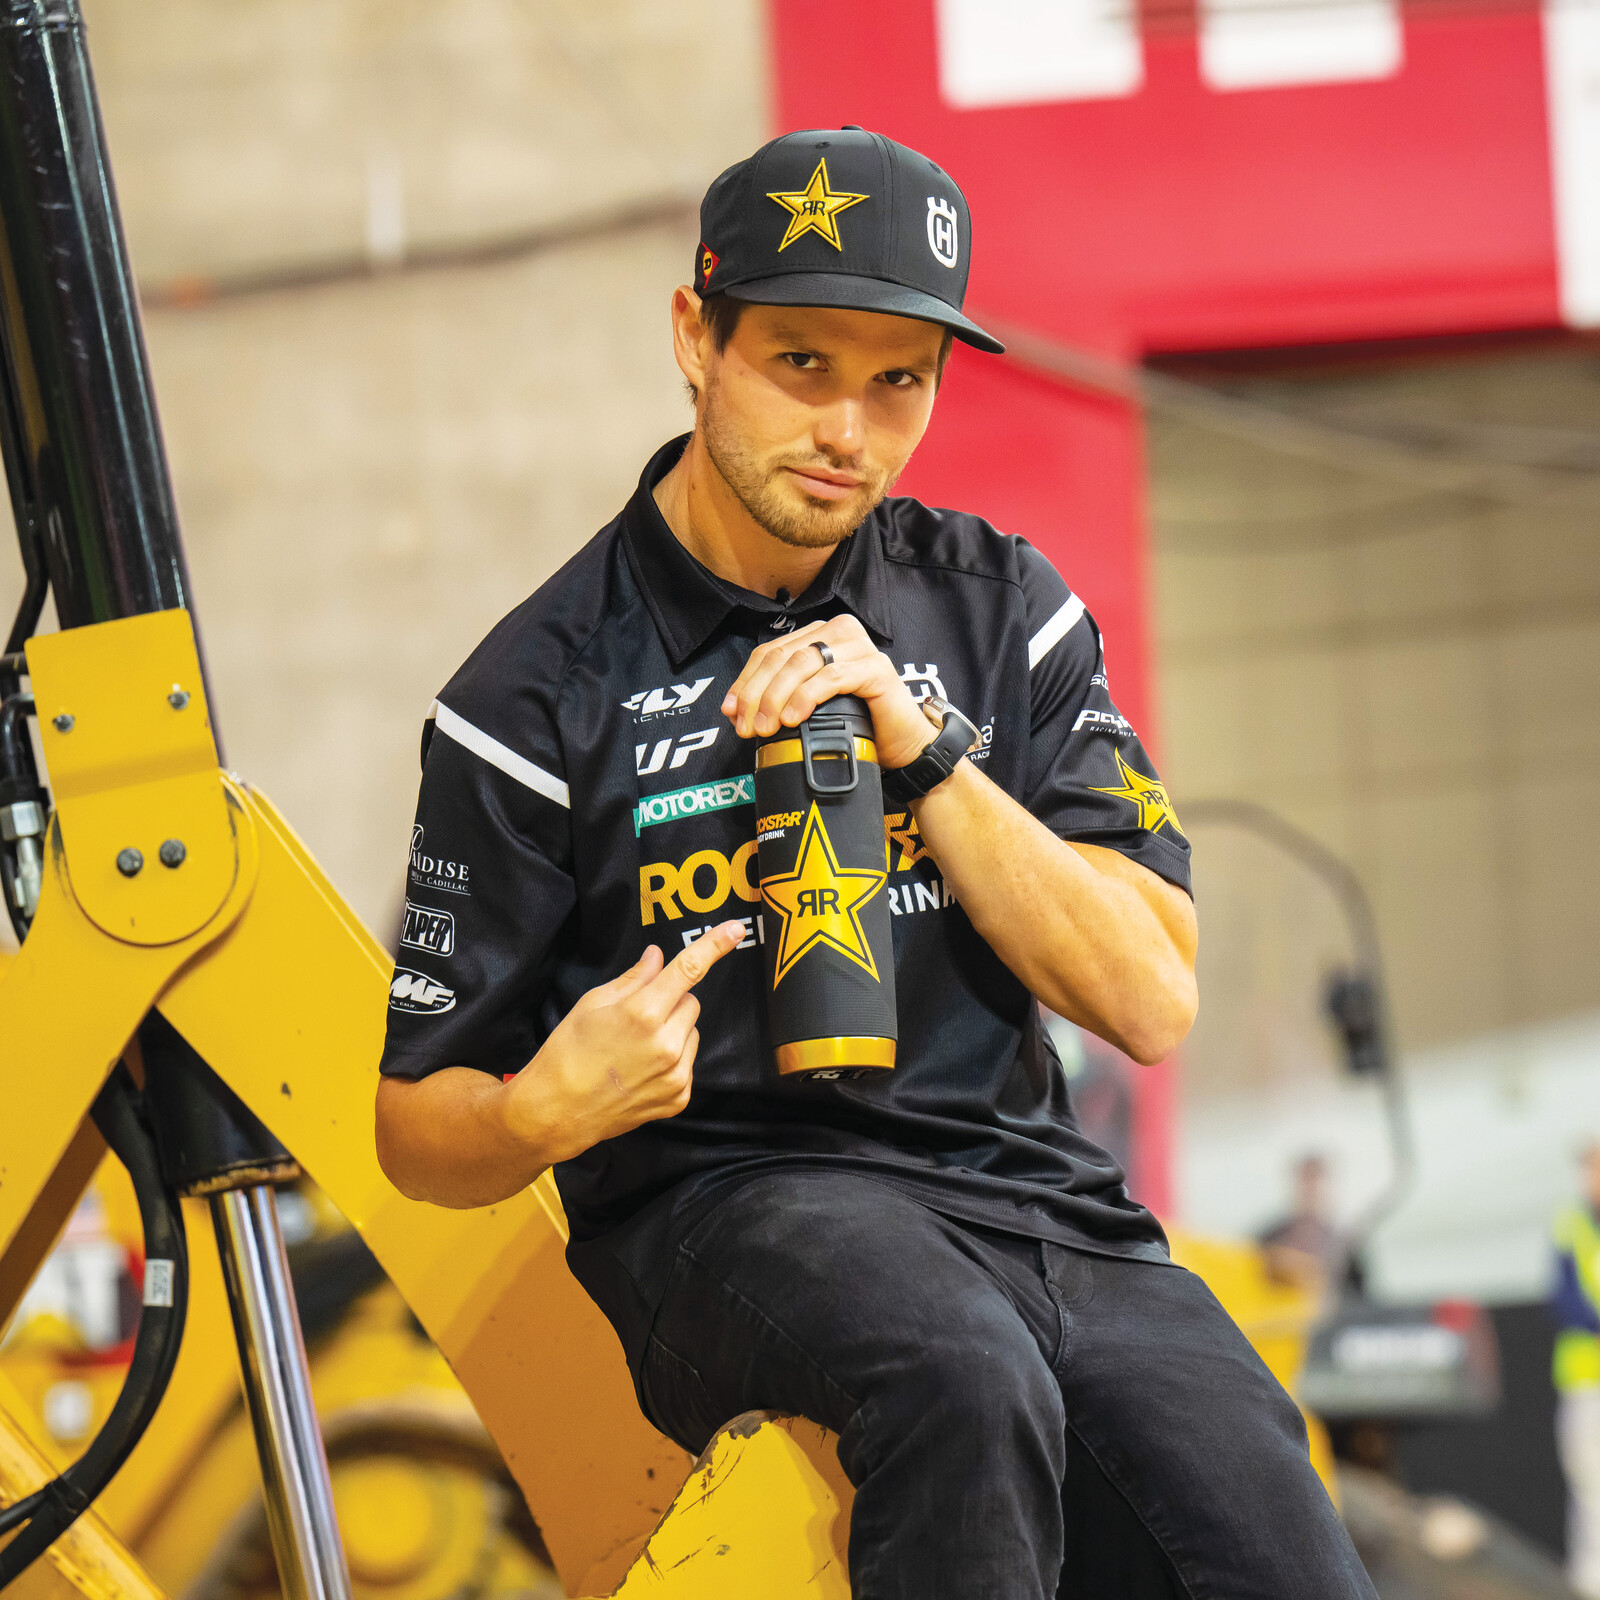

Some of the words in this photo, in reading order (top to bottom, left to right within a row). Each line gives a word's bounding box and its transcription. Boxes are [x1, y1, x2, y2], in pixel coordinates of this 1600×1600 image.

[635, 726, 720, 776] UP
[639, 779, 751, 824] MOTOREX
[765, 829, 785, 841] DRINK
[427, 877, 468, 891] CADILLAC
[639, 839, 762, 927] ROC
